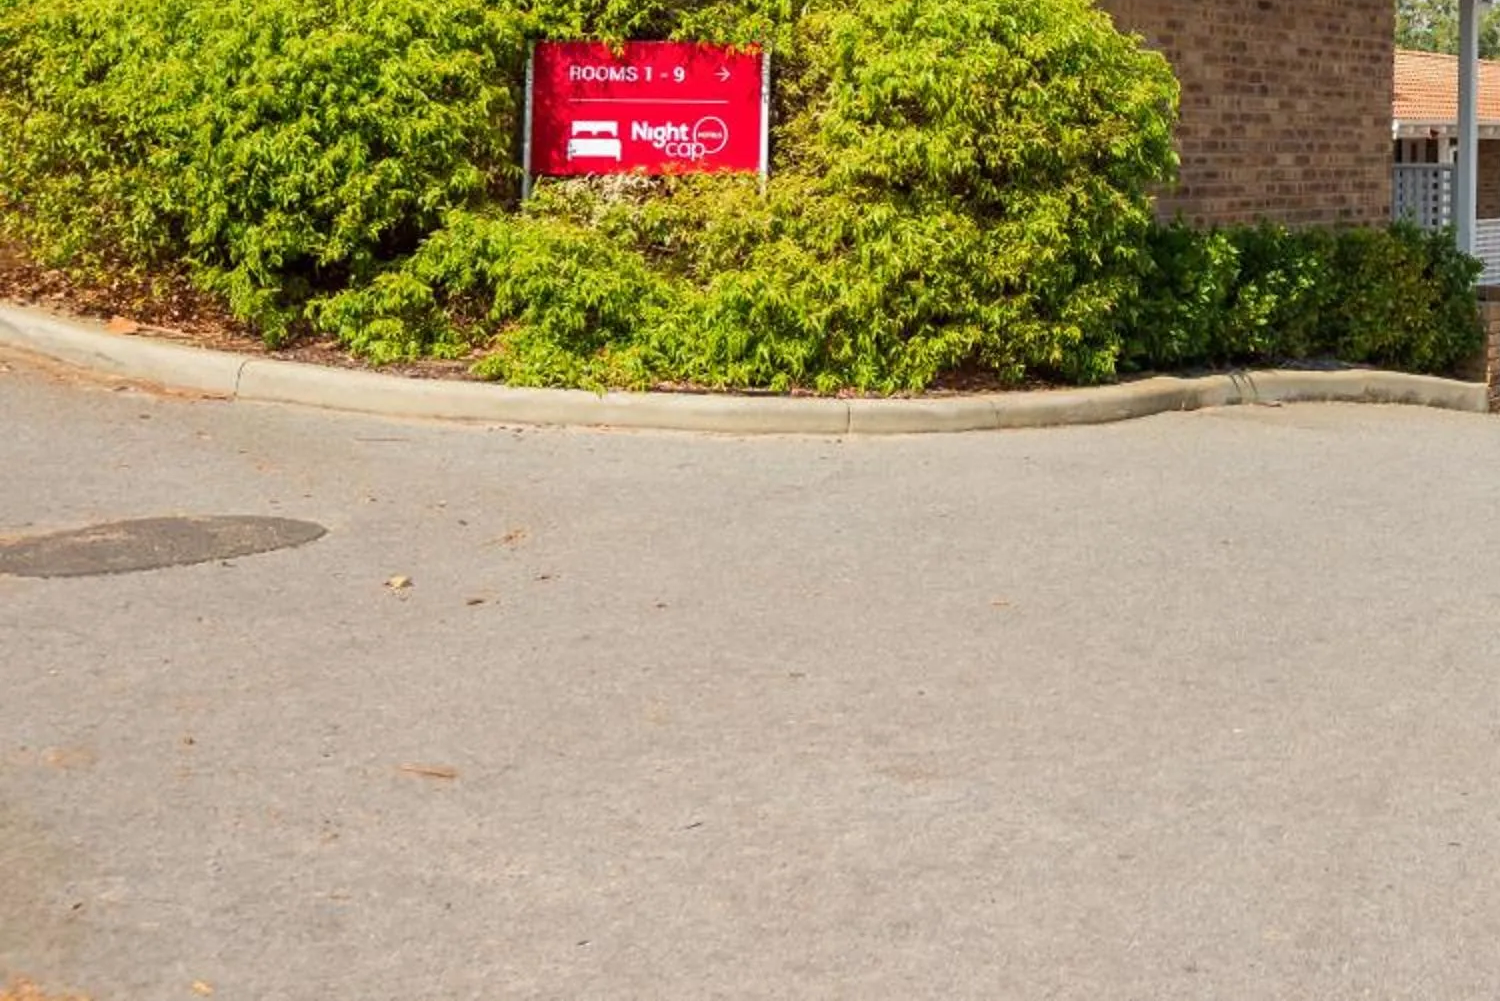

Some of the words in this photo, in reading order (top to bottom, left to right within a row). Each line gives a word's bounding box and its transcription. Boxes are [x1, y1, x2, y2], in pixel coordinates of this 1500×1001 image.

[569, 66, 638, 82] ROOMS
[645, 66, 652, 82] 1
[673, 66, 685, 82] 9
[631, 121, 689, 148] Night
[665, 142, 705, 160] cap
